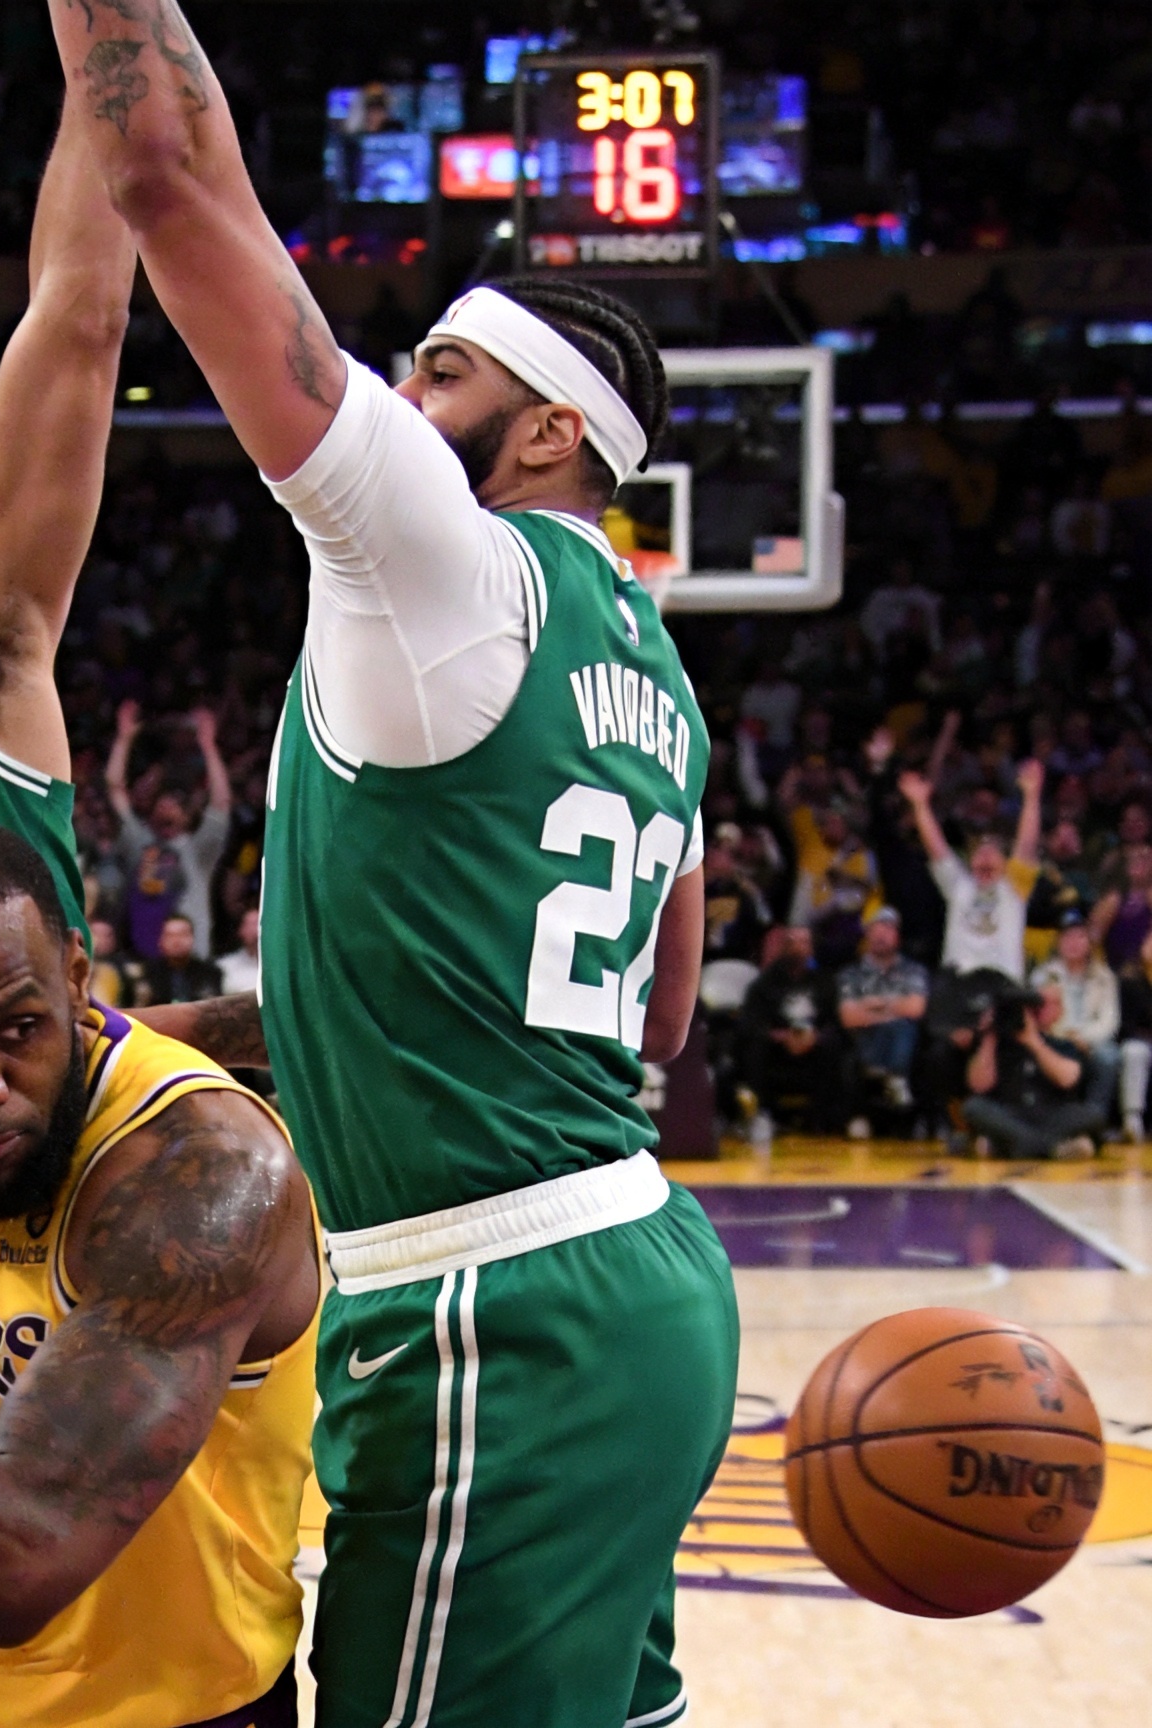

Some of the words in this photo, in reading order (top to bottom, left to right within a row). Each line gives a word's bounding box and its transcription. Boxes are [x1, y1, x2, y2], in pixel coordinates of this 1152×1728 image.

[577, 70, 695, 132] 3:07
[594, 129, 680, 221] 16
[579, 234, 704, 262] TISSOT
[524, 783, 685, 1052] 22
